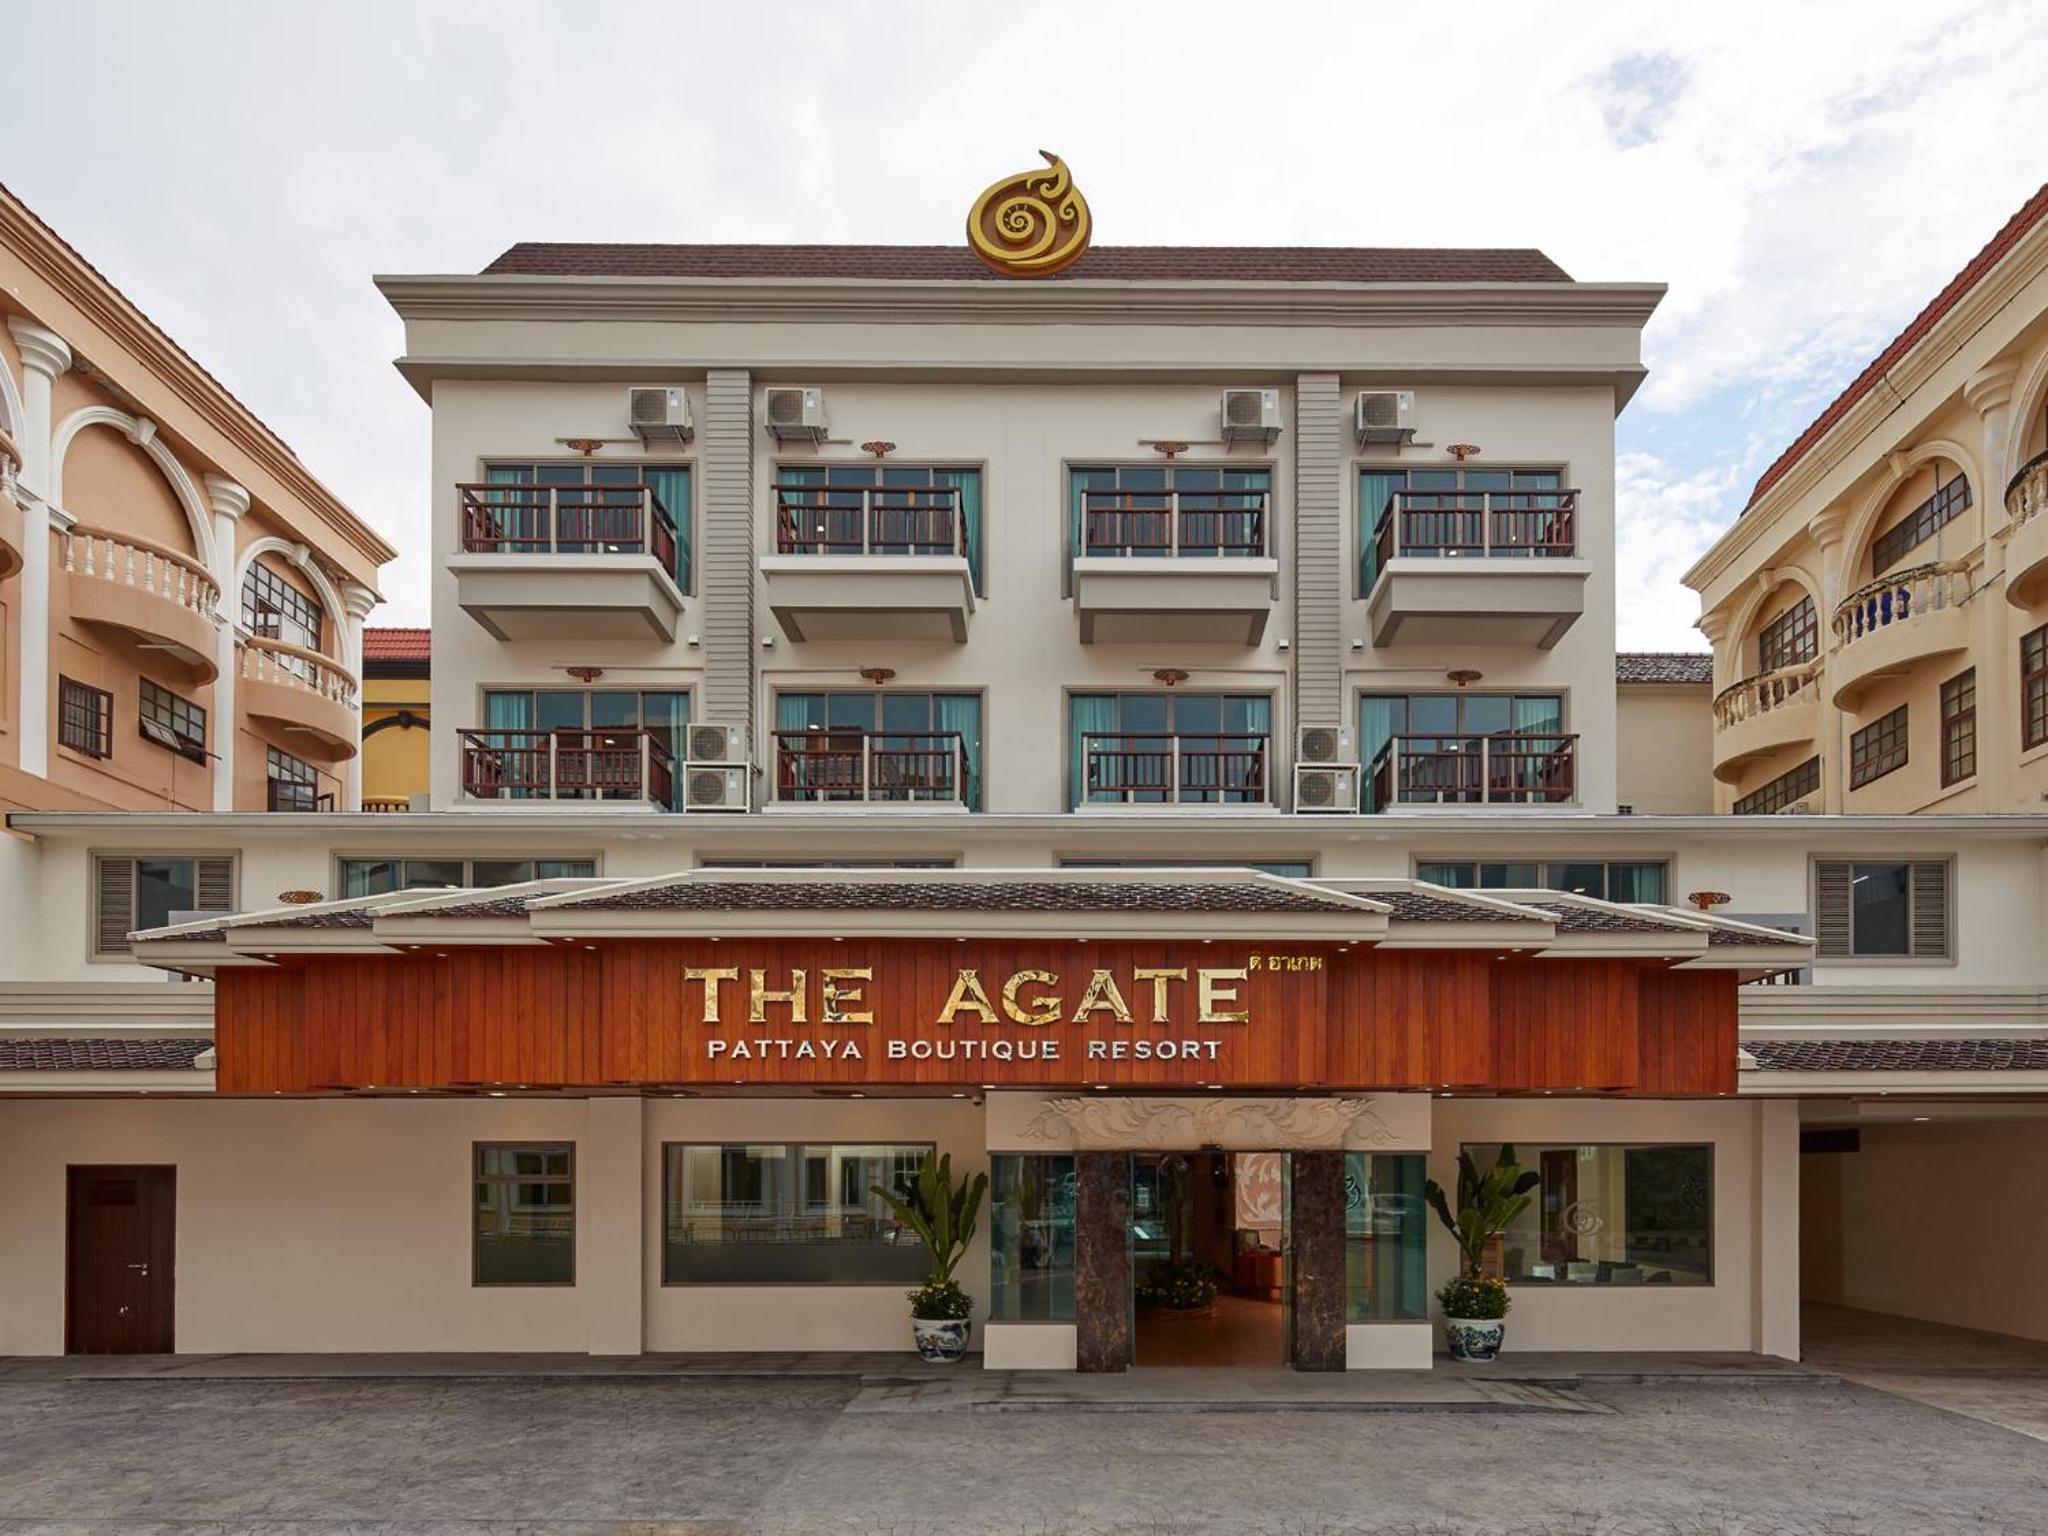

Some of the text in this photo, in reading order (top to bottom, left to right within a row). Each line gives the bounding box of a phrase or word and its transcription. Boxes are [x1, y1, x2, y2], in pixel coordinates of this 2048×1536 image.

[684, 966, 1249, 1026] THE AGATE
[707, 1040, 1222, 1061] PATTAYA BOUTIQUE RESORT
